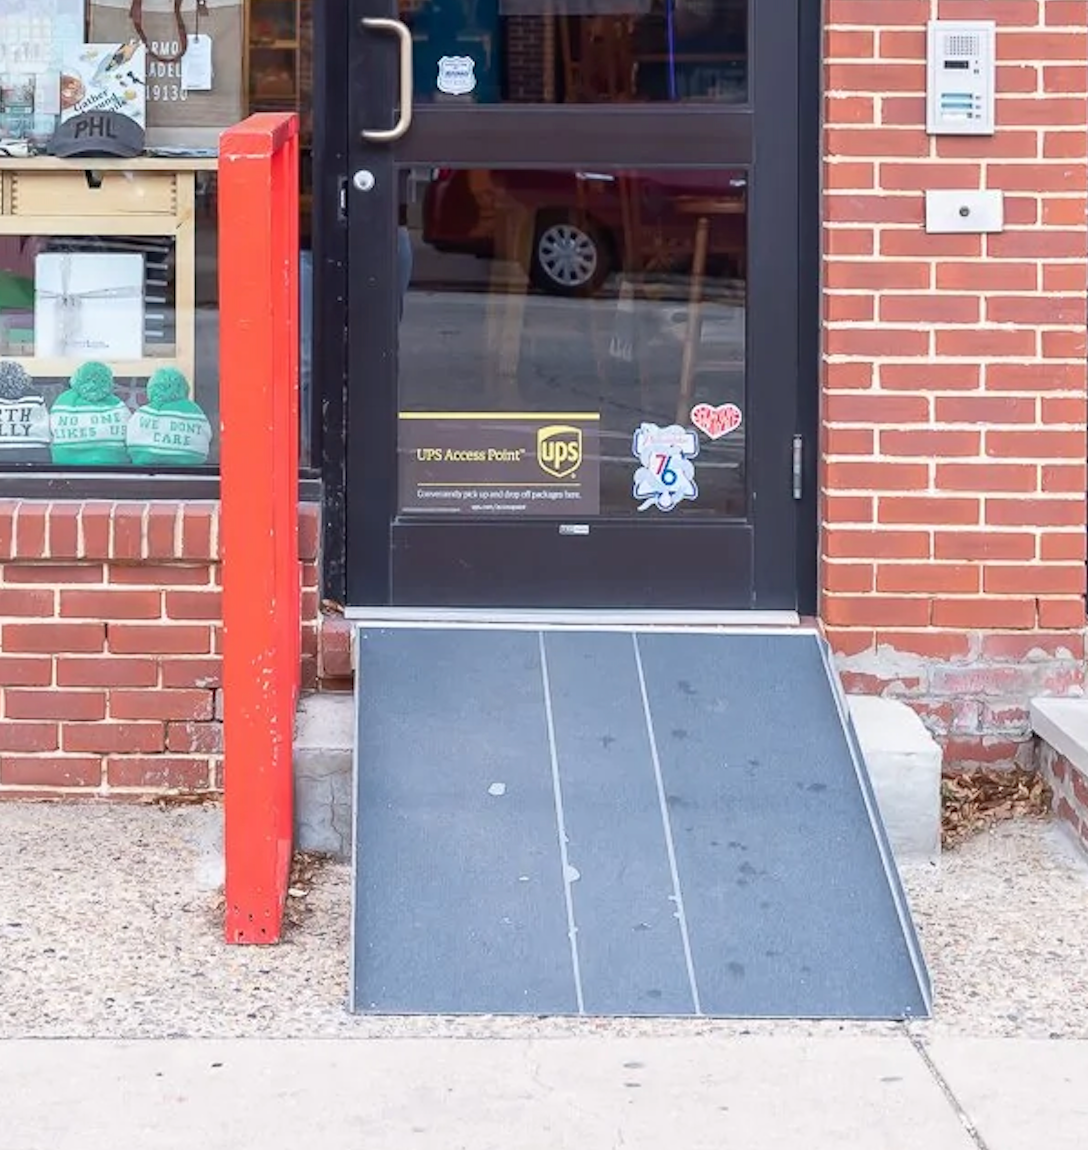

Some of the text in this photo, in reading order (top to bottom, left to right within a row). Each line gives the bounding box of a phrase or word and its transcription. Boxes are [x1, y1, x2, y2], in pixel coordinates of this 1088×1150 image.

[74, 116, 118, 139] PHL
[58, 412, 121, 426] NO ONE
[139, 416, 159, 429] WE
[54, 427, 97, 439] LIKES
[153, 432, 192, 446] CARE
[416, 449, 442, 461] UPS
[444, 449, 486, 461] Access
[542, 440, 579, 469] ups
[655, 453, 678, 486] 76
[463, 490, 478, 499] pick
[479, 491, 489, 499] up
[504, 490, 520, 499] drop
[520, 490, 531, 499] off
[532, 490, 564, 500] packages
